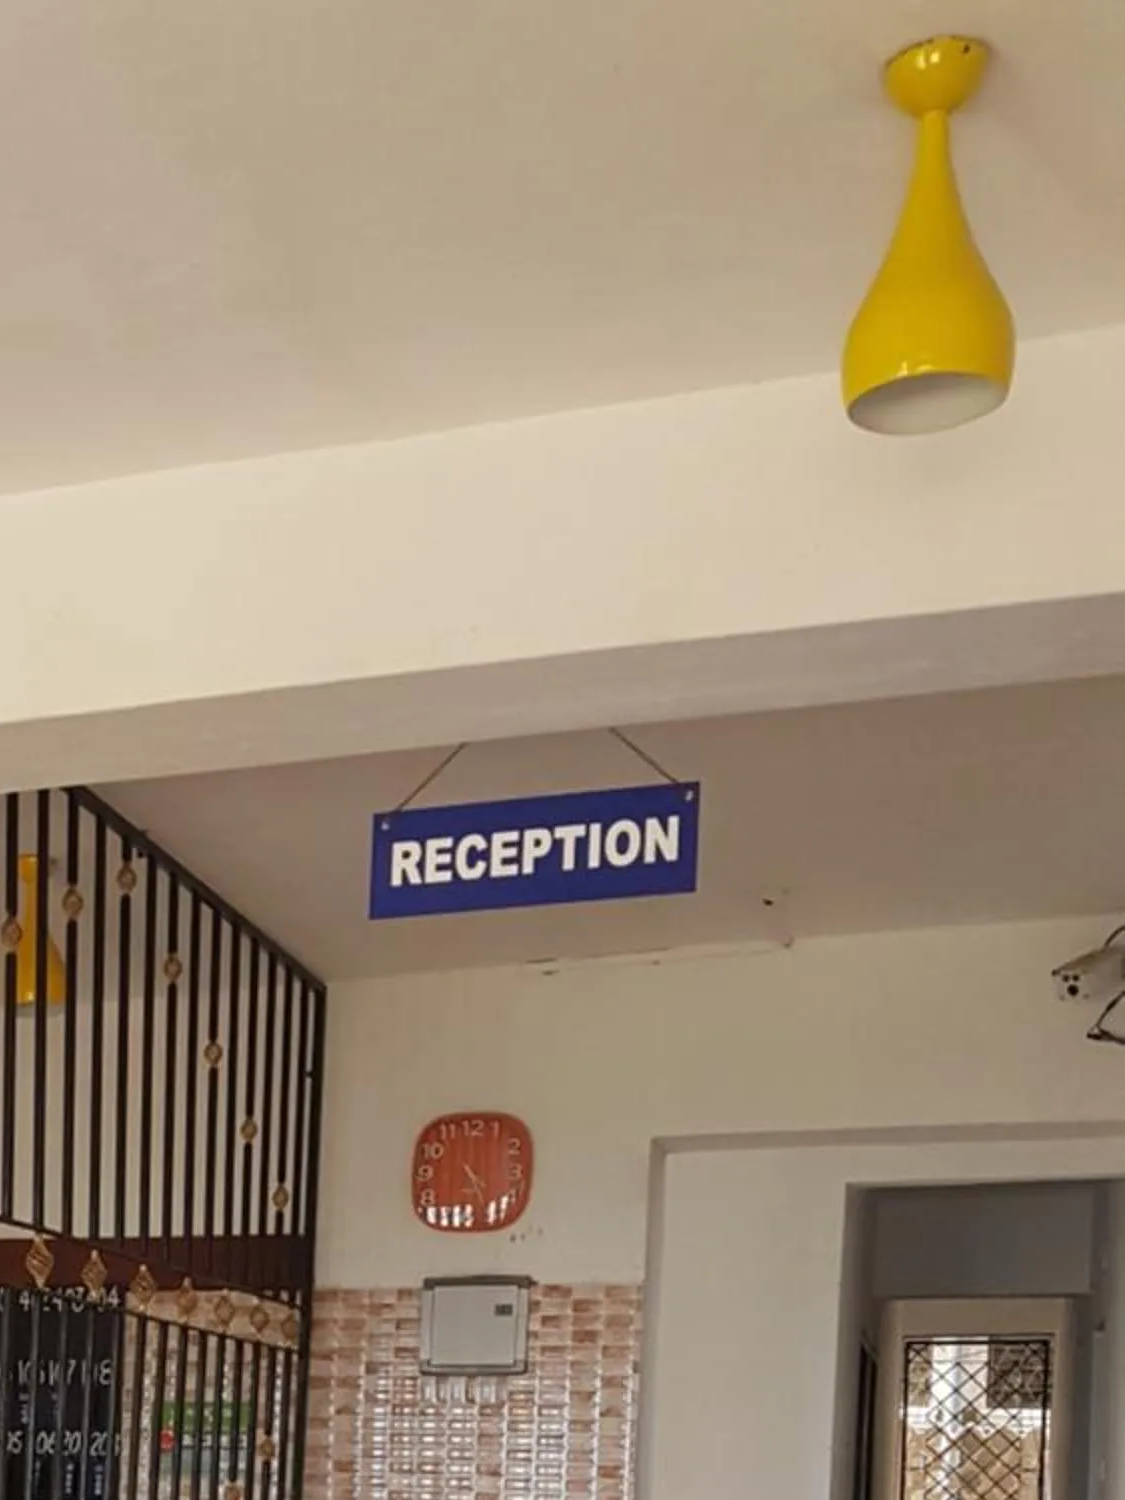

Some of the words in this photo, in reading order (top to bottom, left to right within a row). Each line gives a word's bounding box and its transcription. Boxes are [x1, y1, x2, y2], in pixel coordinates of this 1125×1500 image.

[390, 814, 680, 887] RECEPTION
[440, 1123, 457, 1139] 11
[462, 1119, 484, 1137] 12
[489, 1121, 500, 1139] 1
[422, 1141, 444, 1160] 10
[508, 1137, 521, 1155] 2
[416, 1164, 434, 1182] 9
[509, 1163, 523, 1180] 3
